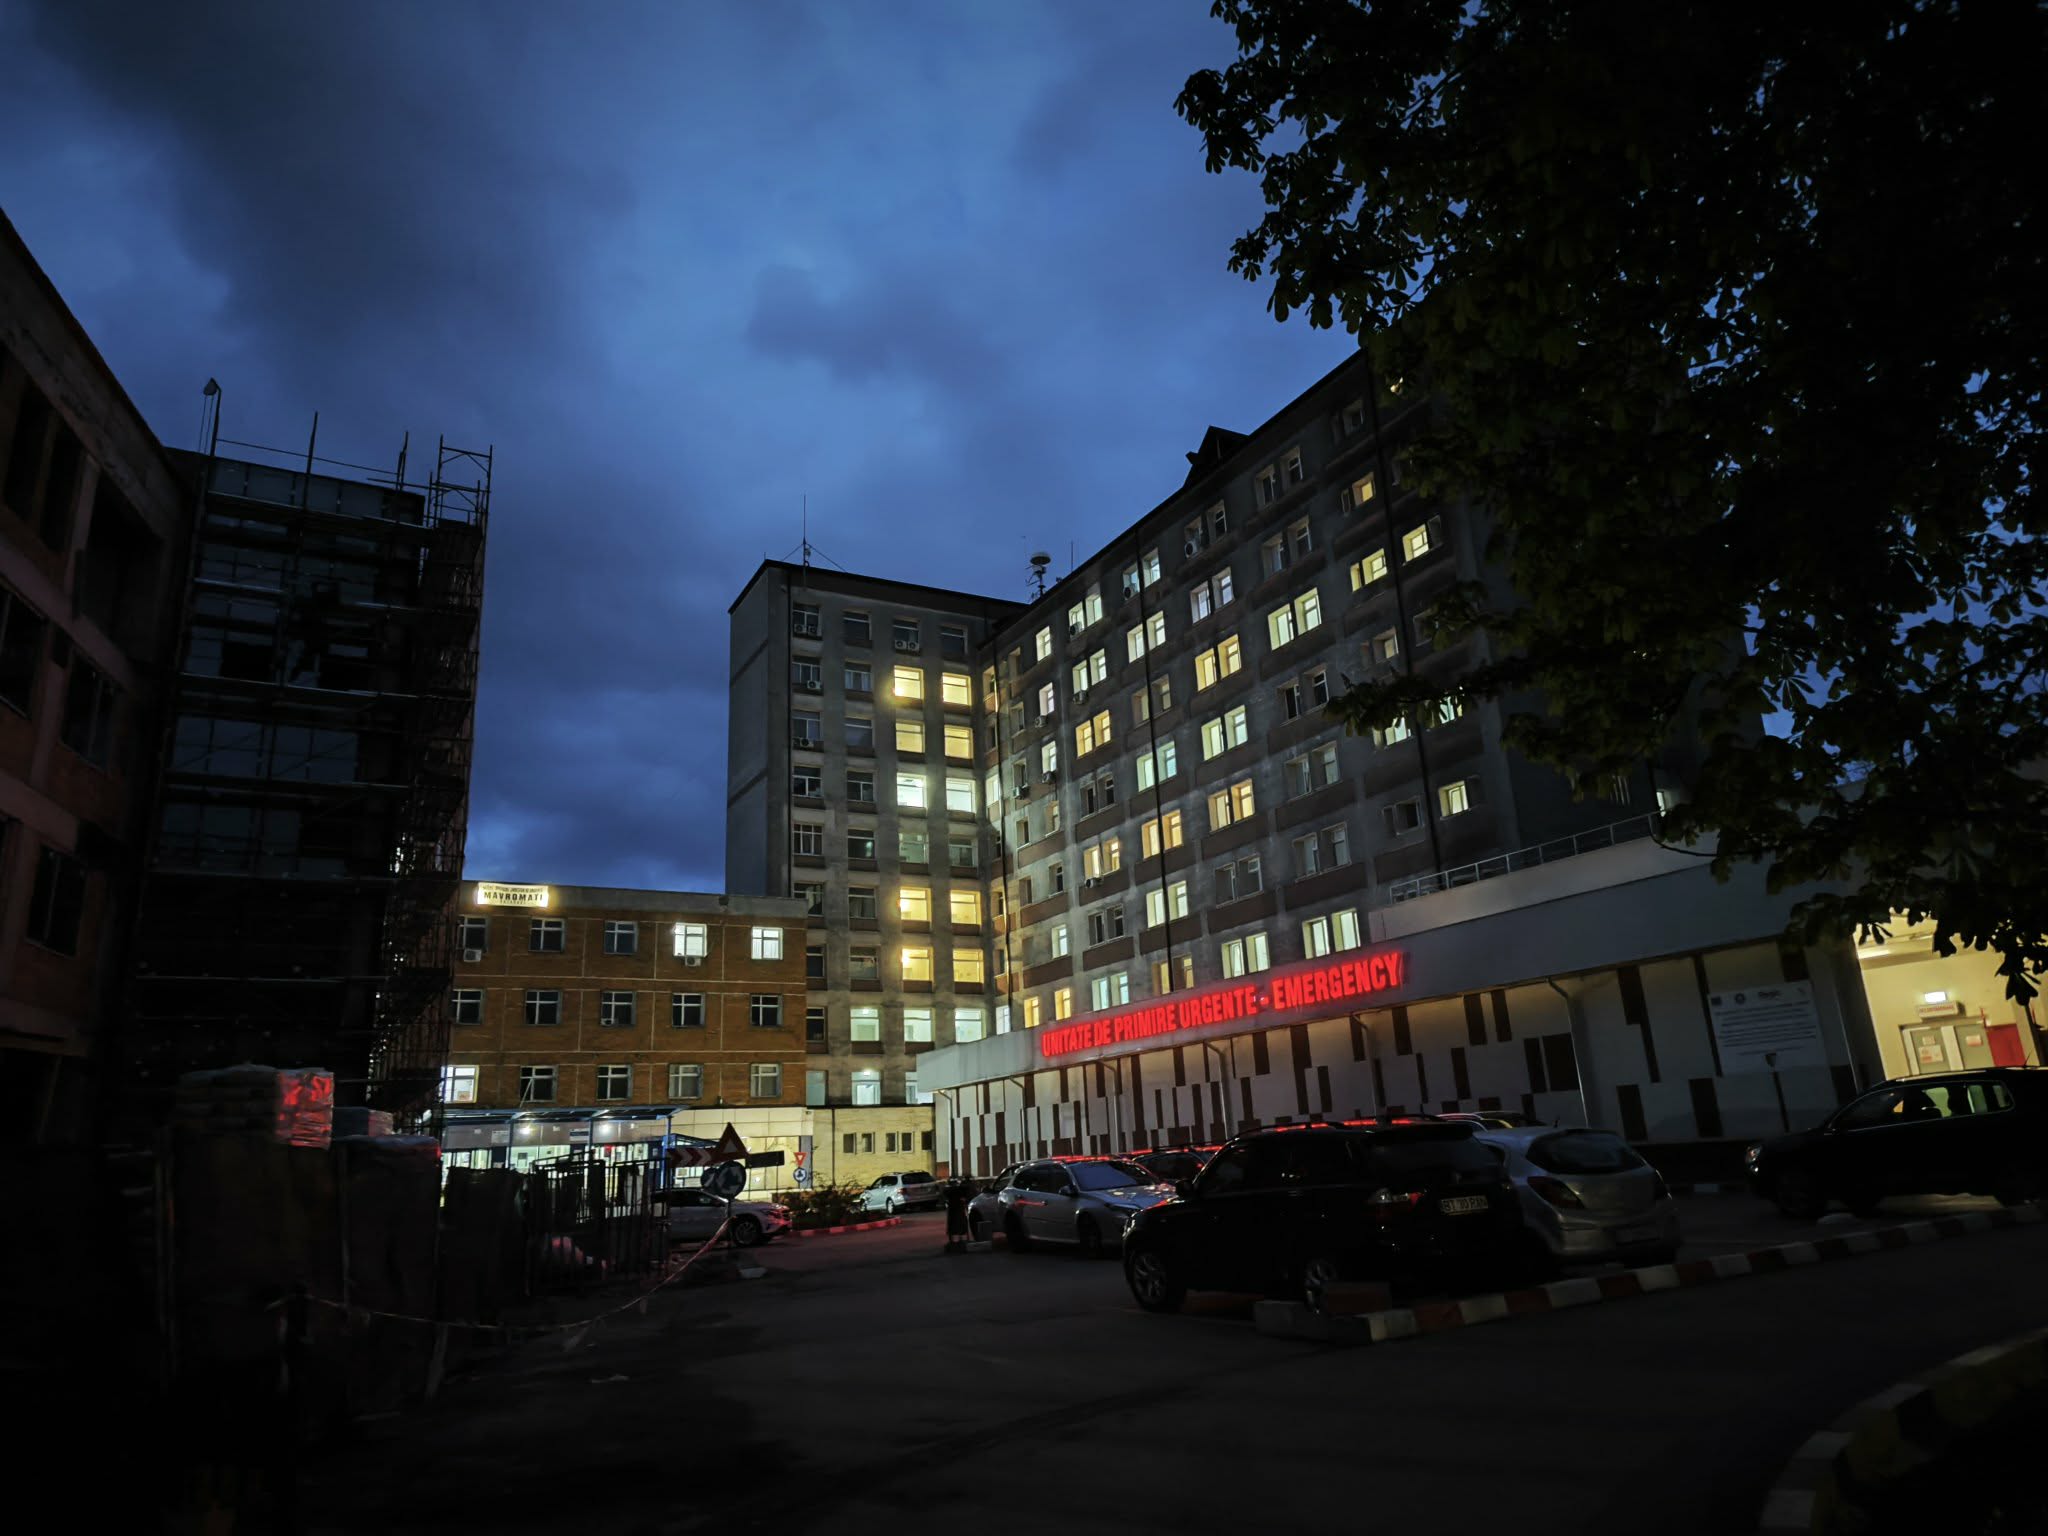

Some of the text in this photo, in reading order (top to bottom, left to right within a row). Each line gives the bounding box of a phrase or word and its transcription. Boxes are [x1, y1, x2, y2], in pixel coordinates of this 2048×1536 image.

[484, 891, 543, 901] MAVROMATI
[1043, 1023, 1091, 1056] UNITATE
[1094, 1019, 1111, 1046] DE
[1114, 1005, 1176, 1041] PRIMIRE
[1179, 986, 1257, 1028] URGENTE
[1272, 952, 1400, 1009] EMERGENCY
